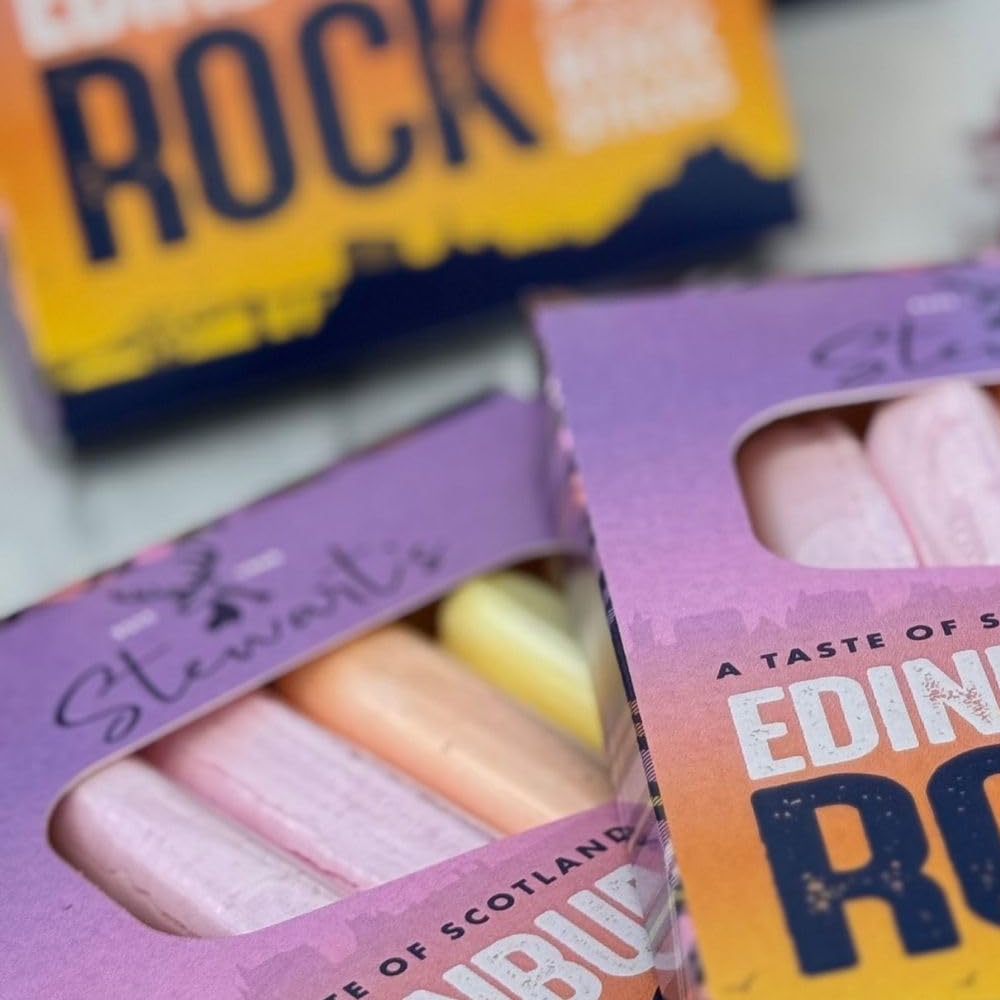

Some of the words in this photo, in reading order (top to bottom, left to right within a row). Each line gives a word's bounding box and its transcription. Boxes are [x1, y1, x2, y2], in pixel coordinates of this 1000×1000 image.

[53, 540, 447, 745] Stewart's
[716, 662, 742, 679] A
[760, 632, 886, 670] TASTE
[905, 619, 960, 641] OF
[379, 942, 427, 976] OF
[441, 824, 648, 940] SCOTLAND
